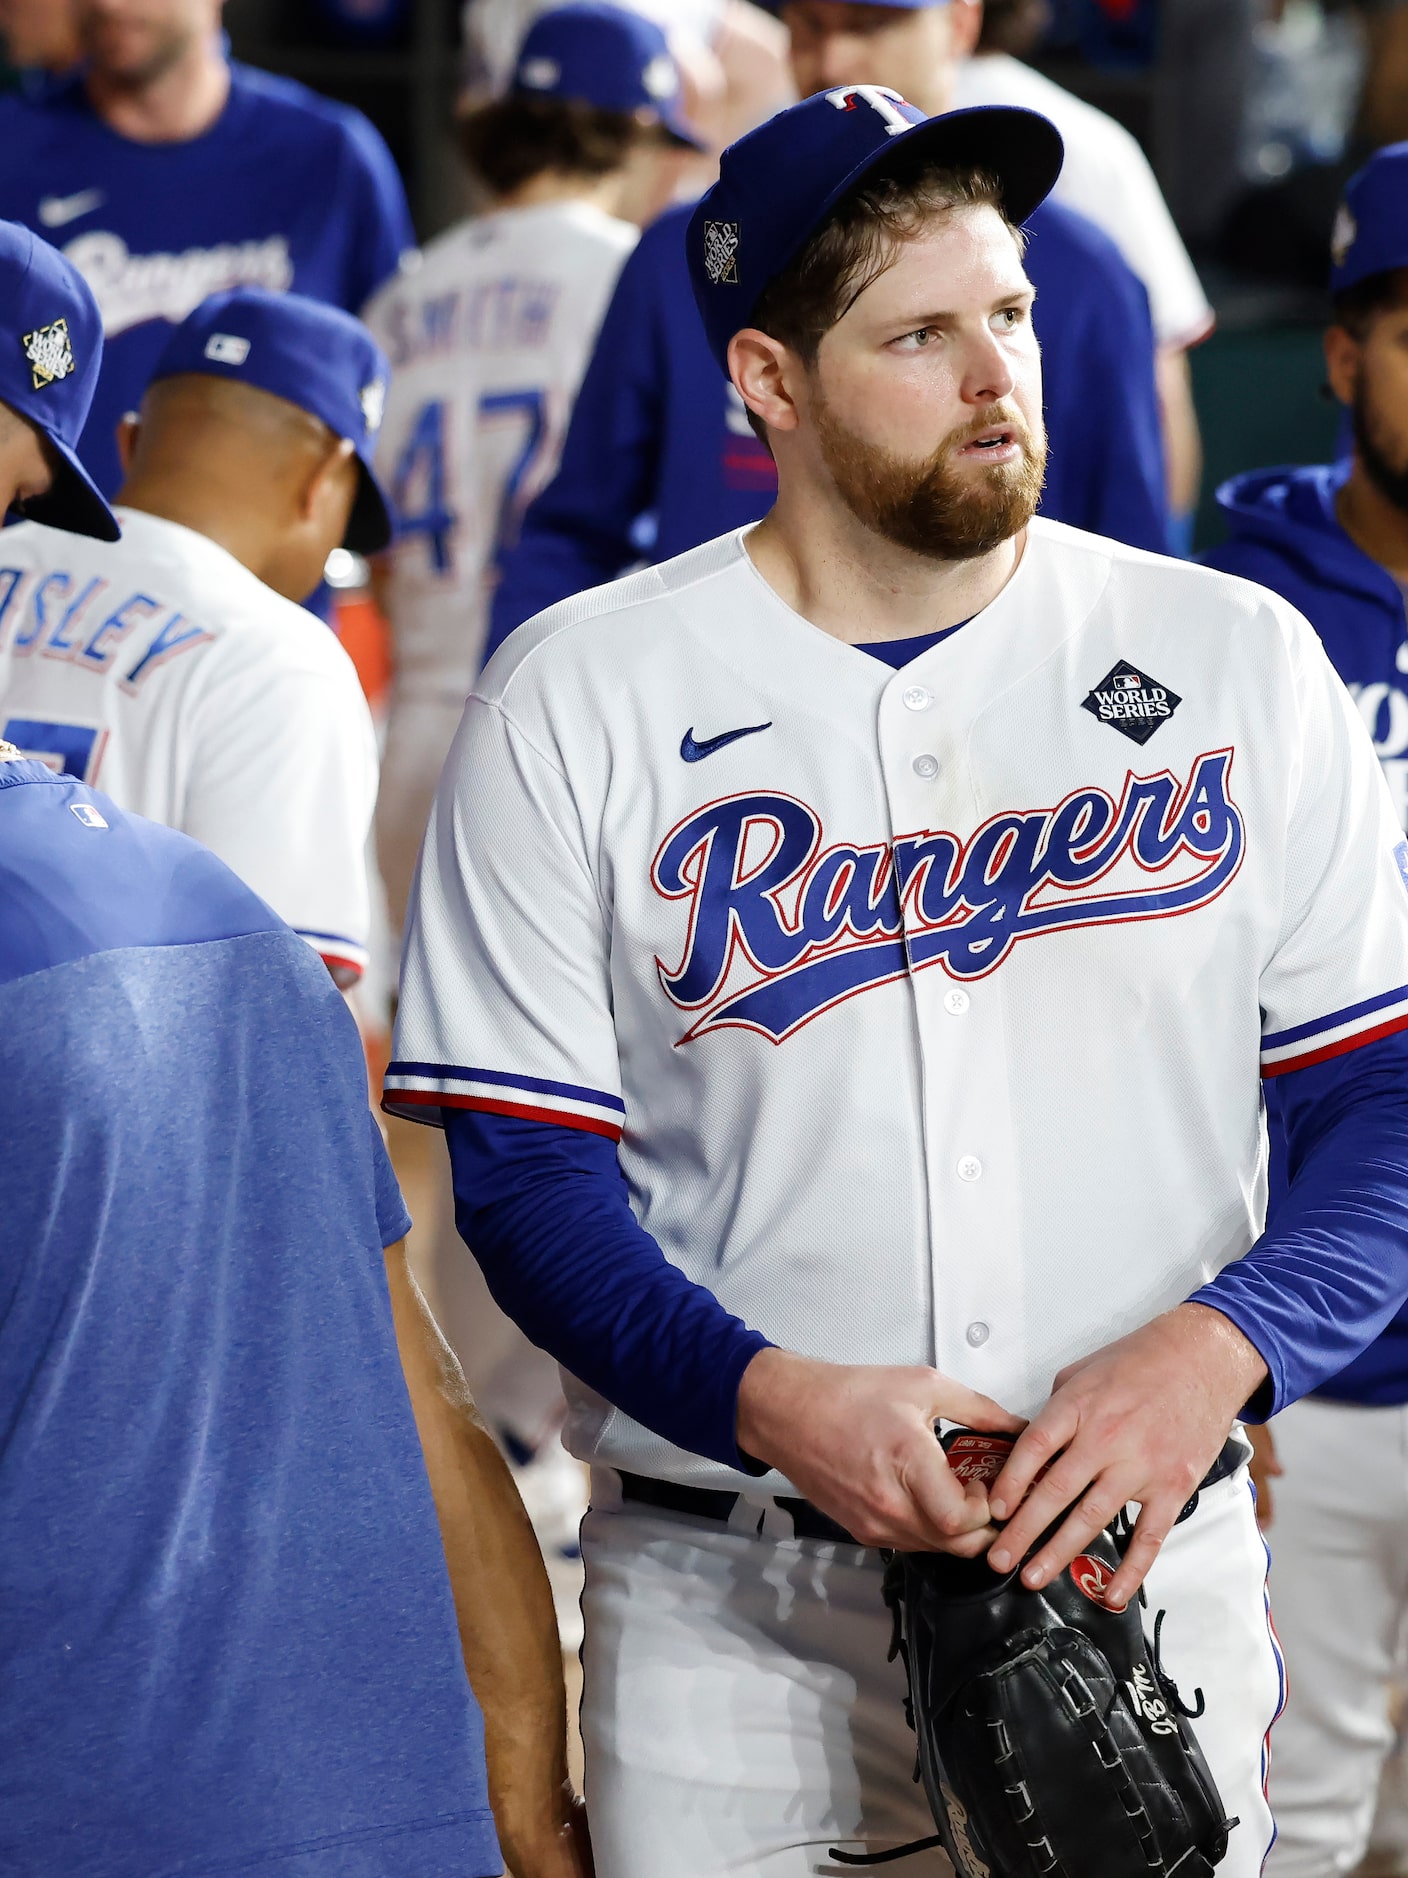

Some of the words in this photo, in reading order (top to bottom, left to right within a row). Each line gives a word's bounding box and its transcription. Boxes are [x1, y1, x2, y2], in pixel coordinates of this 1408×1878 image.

[825, 84, 916, 136] T
[705, 223, 732, 273] WORLD
[711, 233, 739, 285] SERIES
[1093, 688, 1167, 705] WORLD
[1098, 701, 1171, 720] SERIES
[650, 746, 1247, 1047] Rangers
